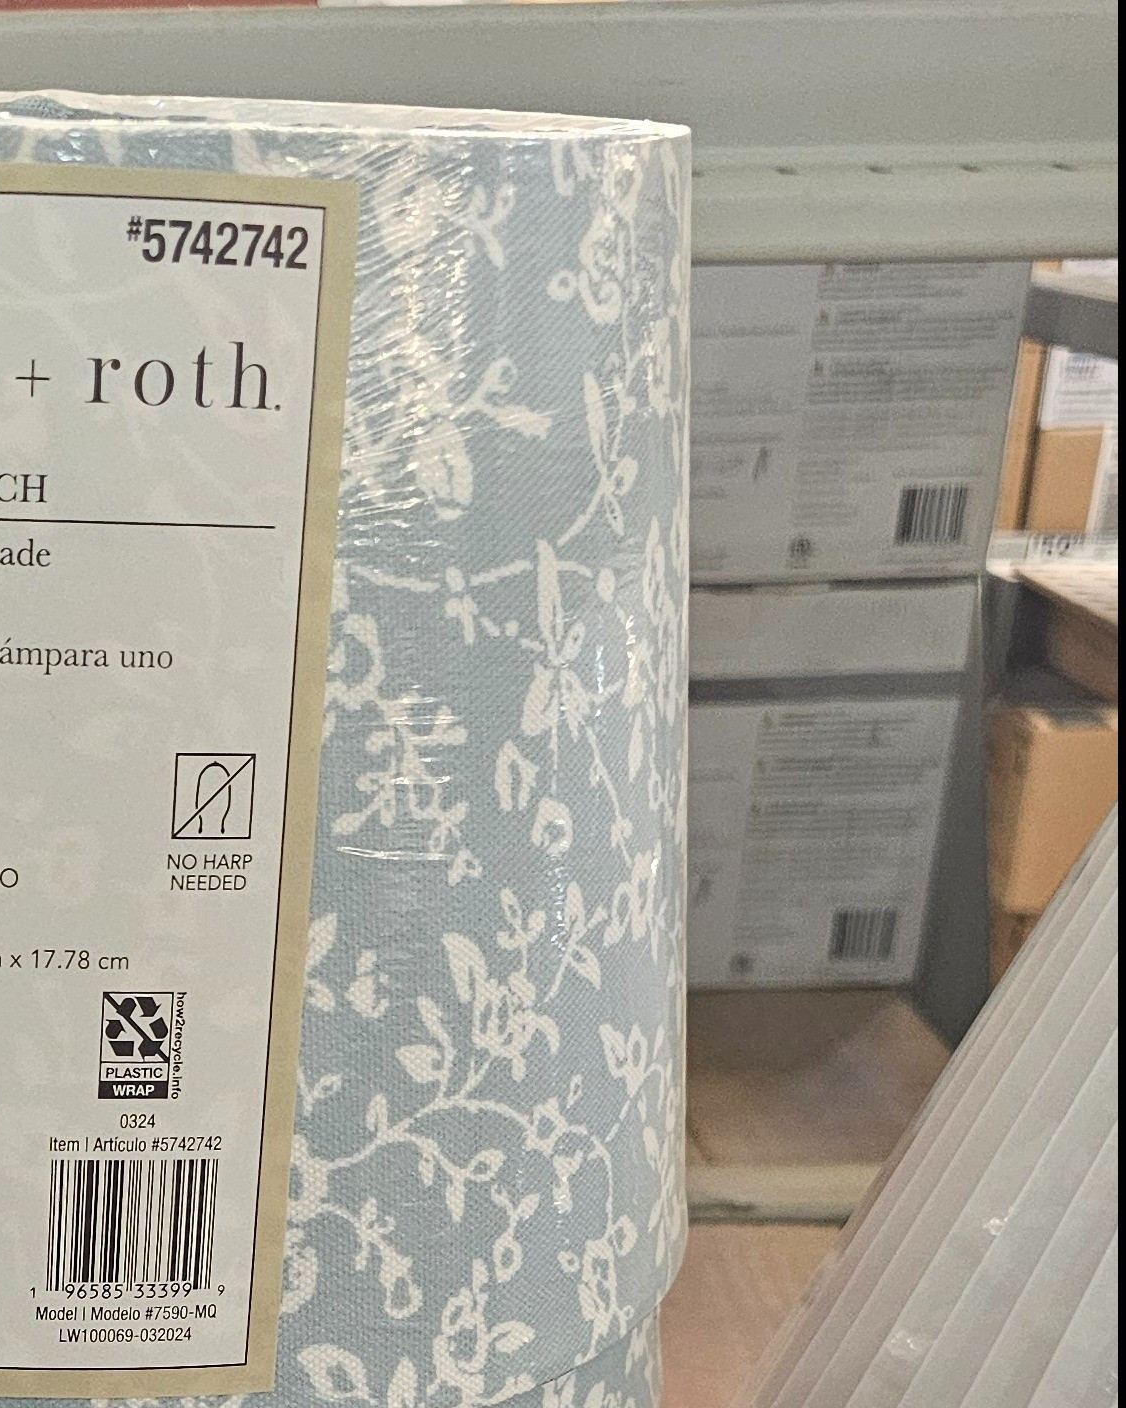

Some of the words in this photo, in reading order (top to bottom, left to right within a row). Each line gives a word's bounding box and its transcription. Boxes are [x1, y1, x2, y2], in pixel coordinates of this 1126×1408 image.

[127, 216, 309, 269] #5742742
[15, 359, 49, 398] +
[120, 648, 174, 670] uno
[167, 854, 197, 870] NO
[203, 854, 253, 870] HARP
[170, 874, 247, 891] NEEDED
[31, 950, 91, 970] 17.78
[98, 953, 130, 971] cm
[171, 991, 187, 1100] how2recycle.info
[105, 1067, 163, 1079] PLASTIC
[112, 1085, 155, 1096] WRAP
[120, 1114, 156, 1128] 0324
[49, 1137, 80, 1152] Item
[93, 1137, 147, 1152] Artículo
[151, 1136, 222, 1151] #5742742
[65, 1284, 124, 1299] 96585
[134, 1282, 192, 1299] 33399
[36, 1306, 77, 1320] Model
[91, 1306, 141, 1320] Modelo
[145, 1304, 217, 1320] #7590-MQ
[59, 1327, 192, 1343] LW100069-032024
